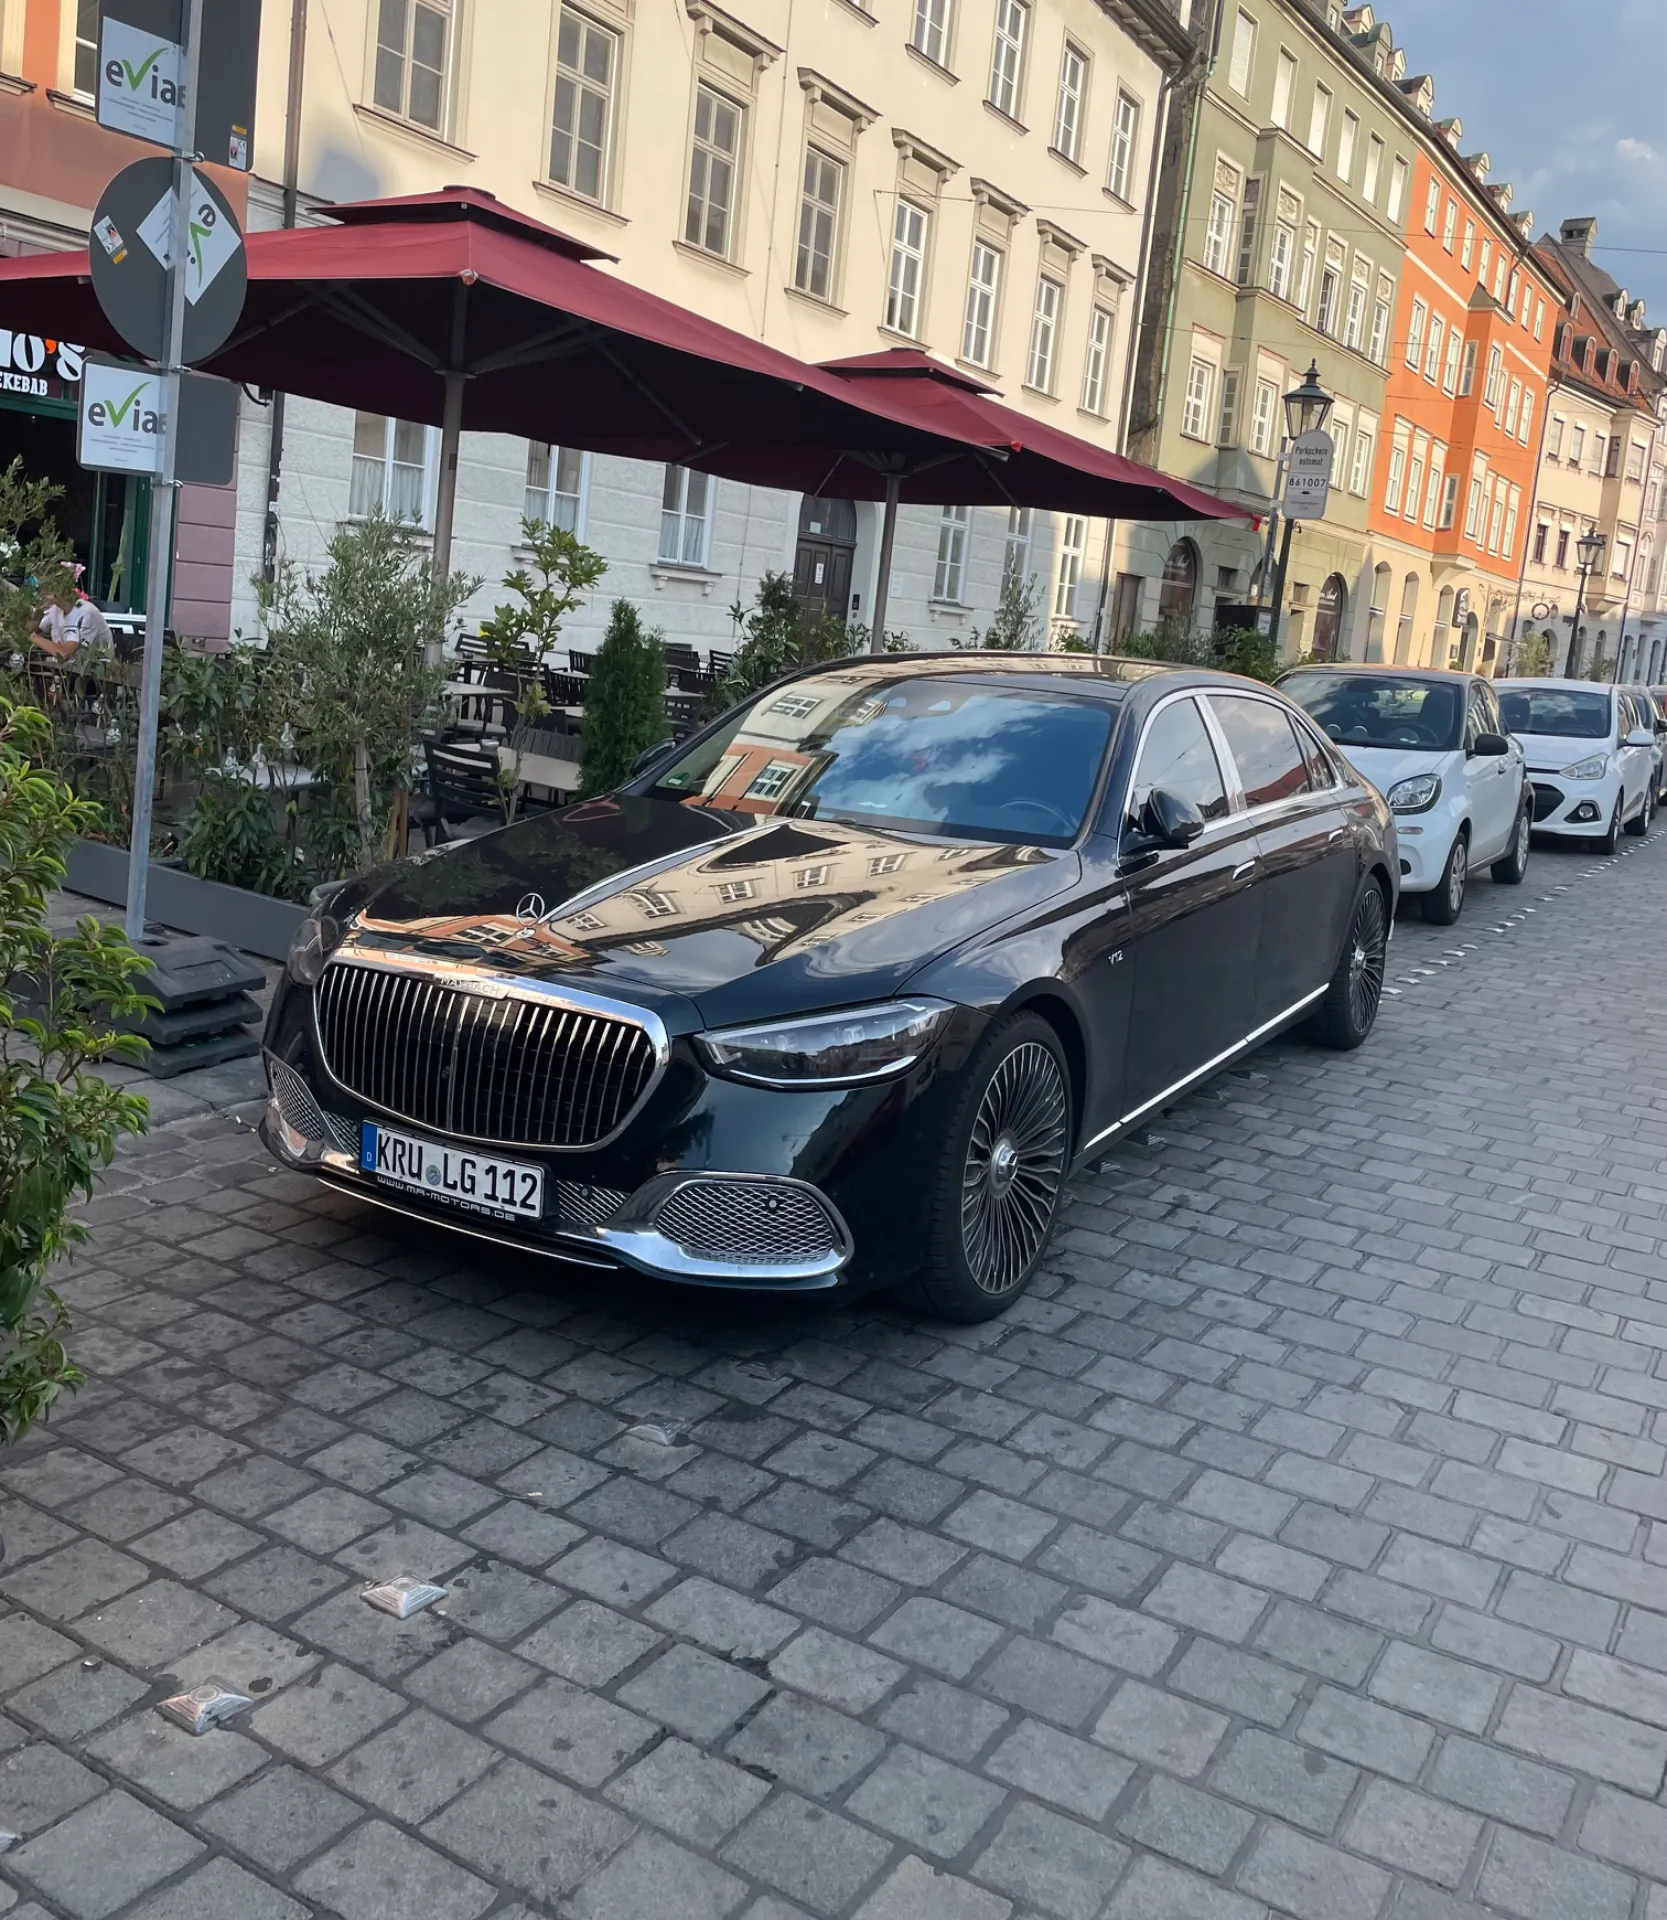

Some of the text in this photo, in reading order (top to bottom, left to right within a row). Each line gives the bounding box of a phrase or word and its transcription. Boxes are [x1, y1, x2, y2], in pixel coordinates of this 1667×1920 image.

[0, 372, 48, 396] KEBAB
[1289, 478, 1326, 487] 861007
[366, 1151, 372, 1162] D
[377, 1133, 537, 1211] KRU LG 112
